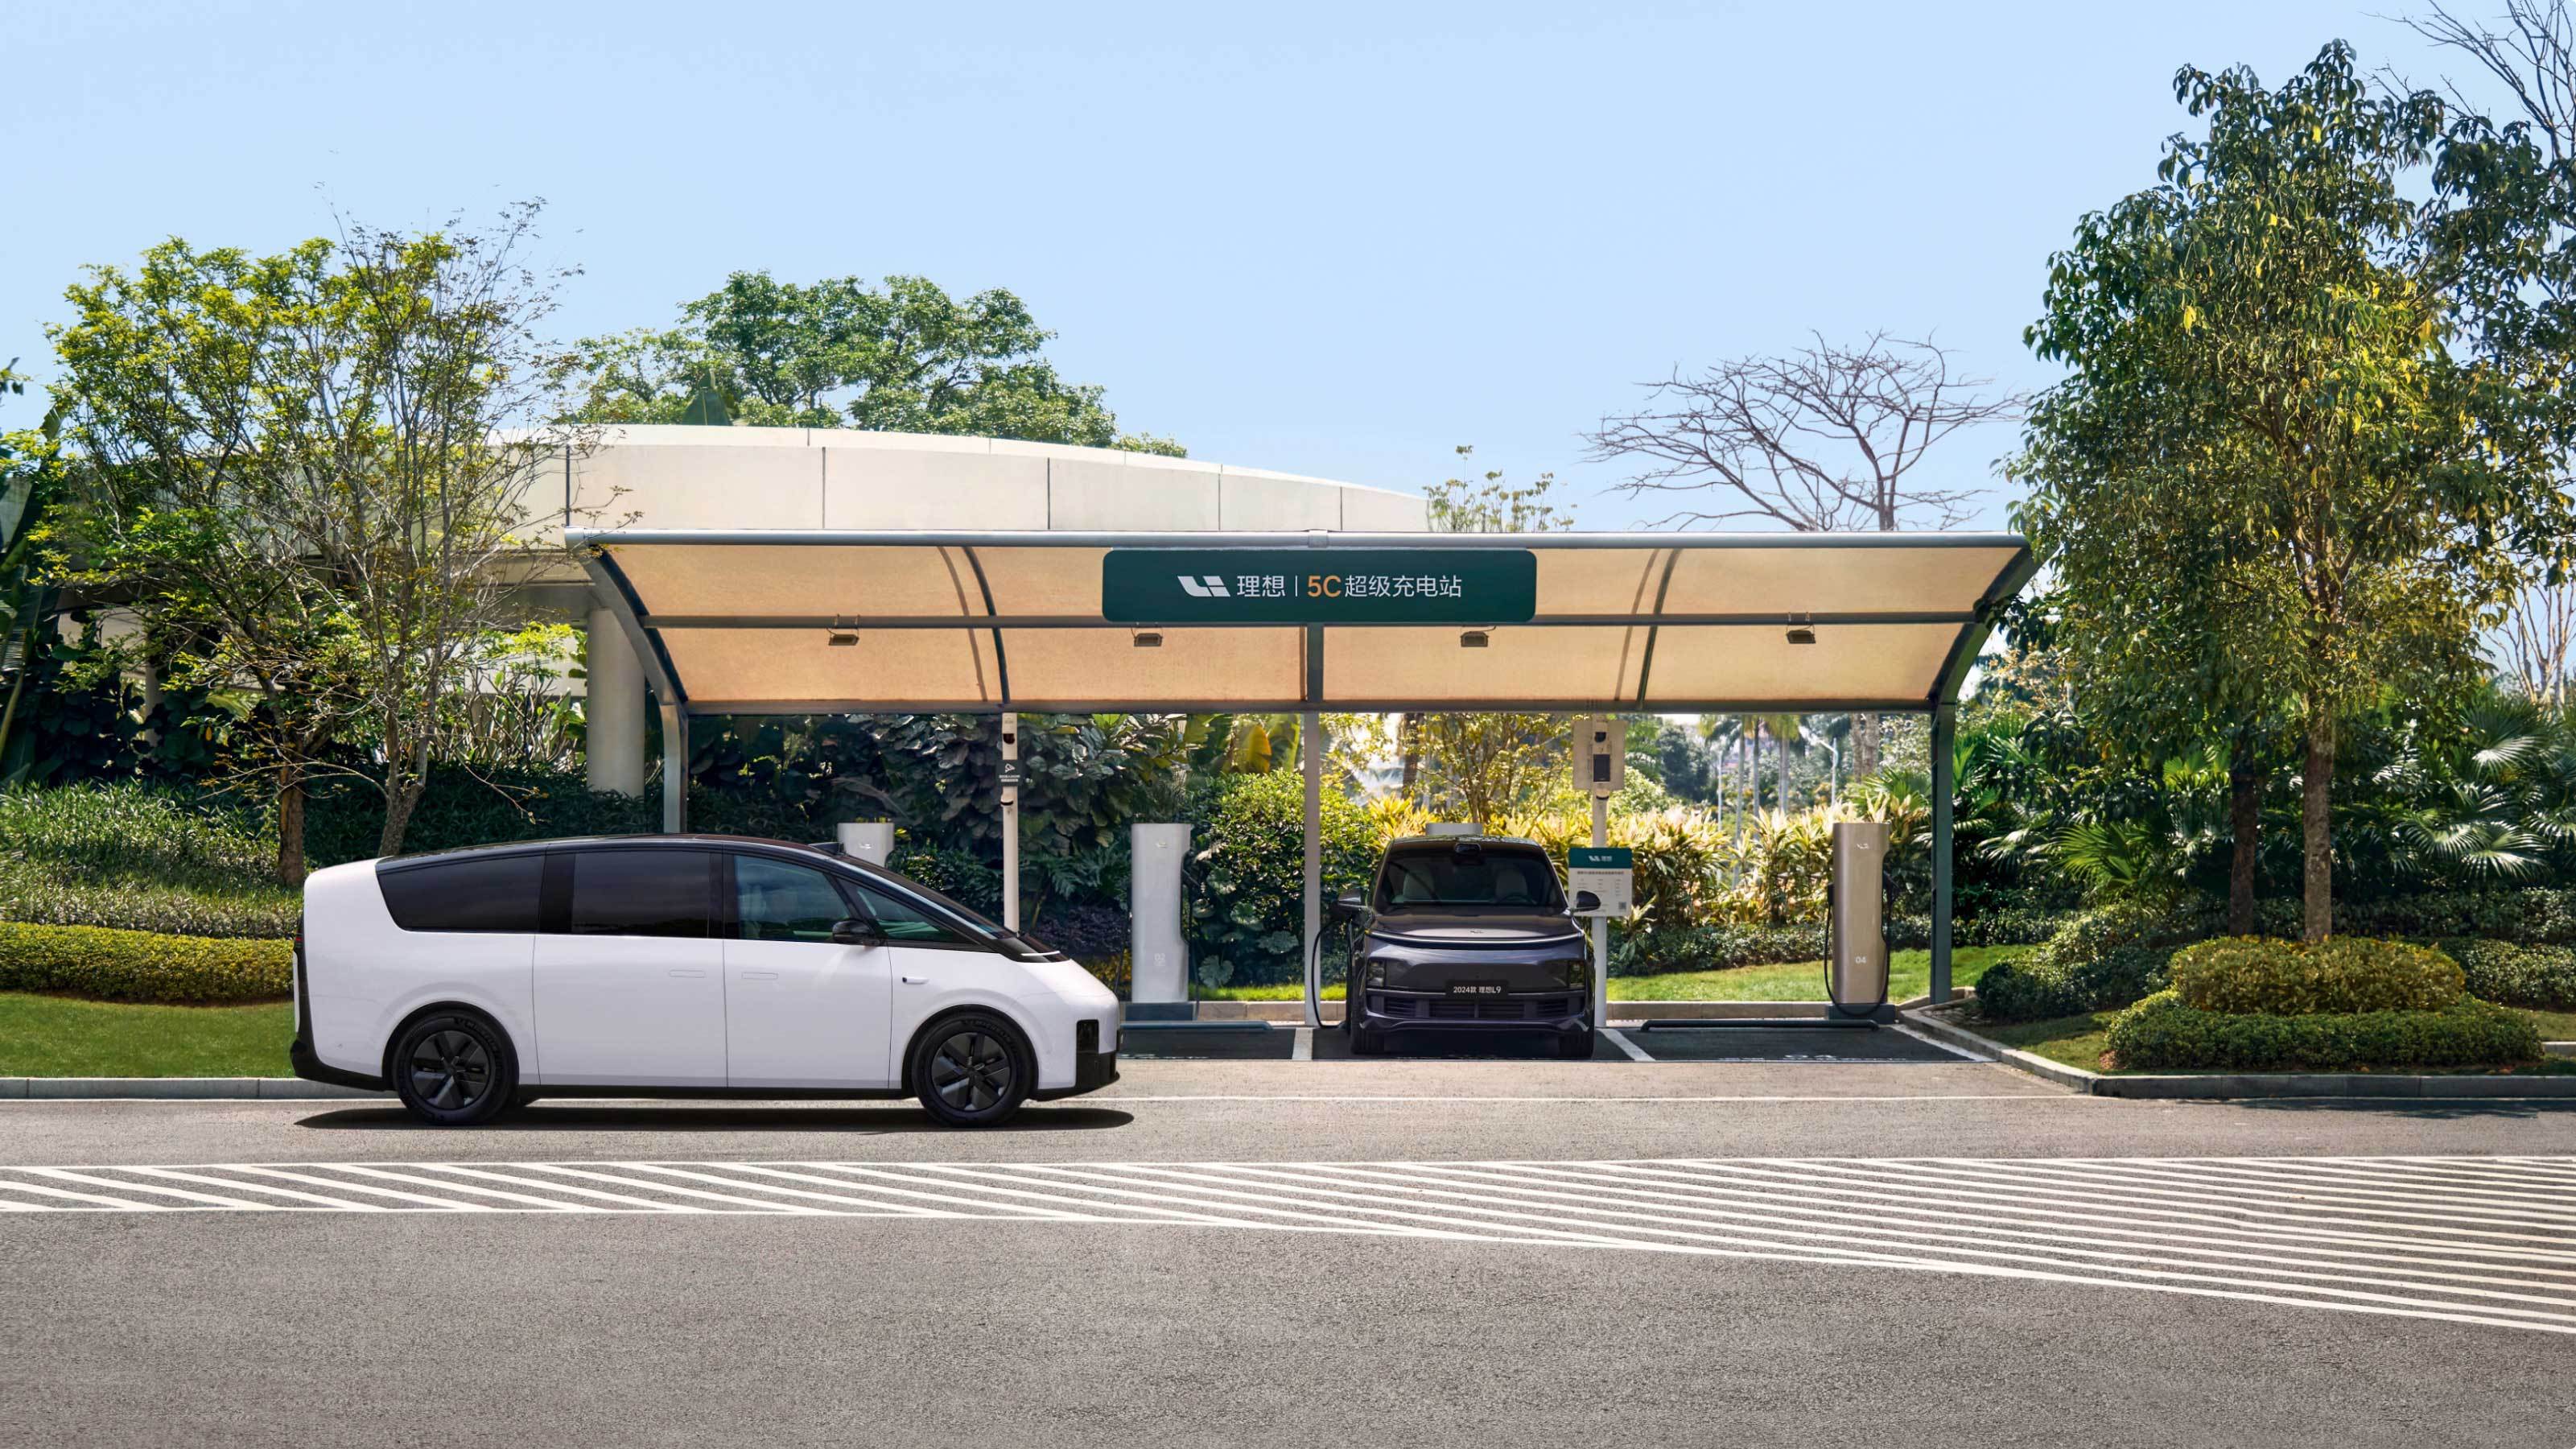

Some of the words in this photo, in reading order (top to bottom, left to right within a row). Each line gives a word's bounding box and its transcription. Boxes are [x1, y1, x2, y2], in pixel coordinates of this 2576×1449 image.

[1237, 575, 1285, 597] 理想
[1307, 575, 1462, 597] 5C超级充电站
[1855, 956, 1867, 964] 04
